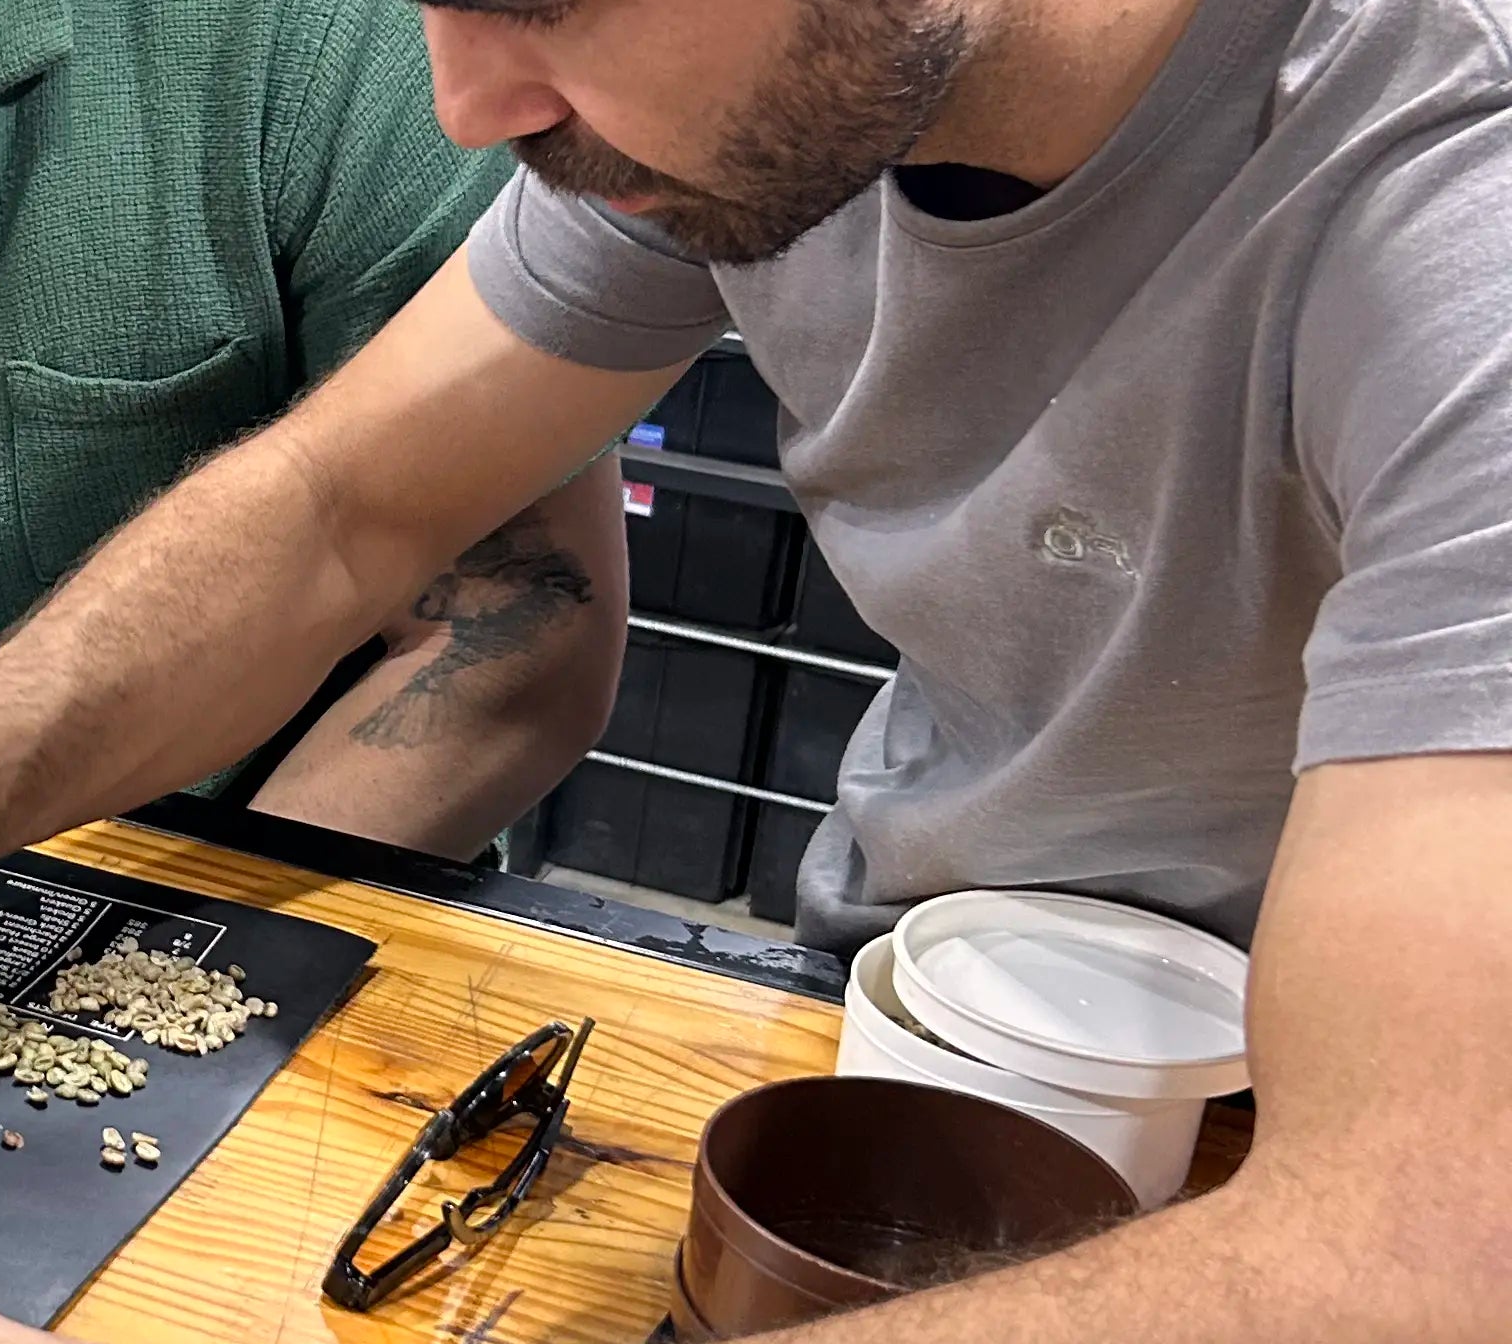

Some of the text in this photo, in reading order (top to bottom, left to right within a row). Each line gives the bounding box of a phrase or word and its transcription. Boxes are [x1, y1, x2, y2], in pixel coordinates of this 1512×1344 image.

[6, 879, 89, 906] Green/Immature
[40, 905, 76, 920] Broken
[40, 913, 71, 927] Shells
